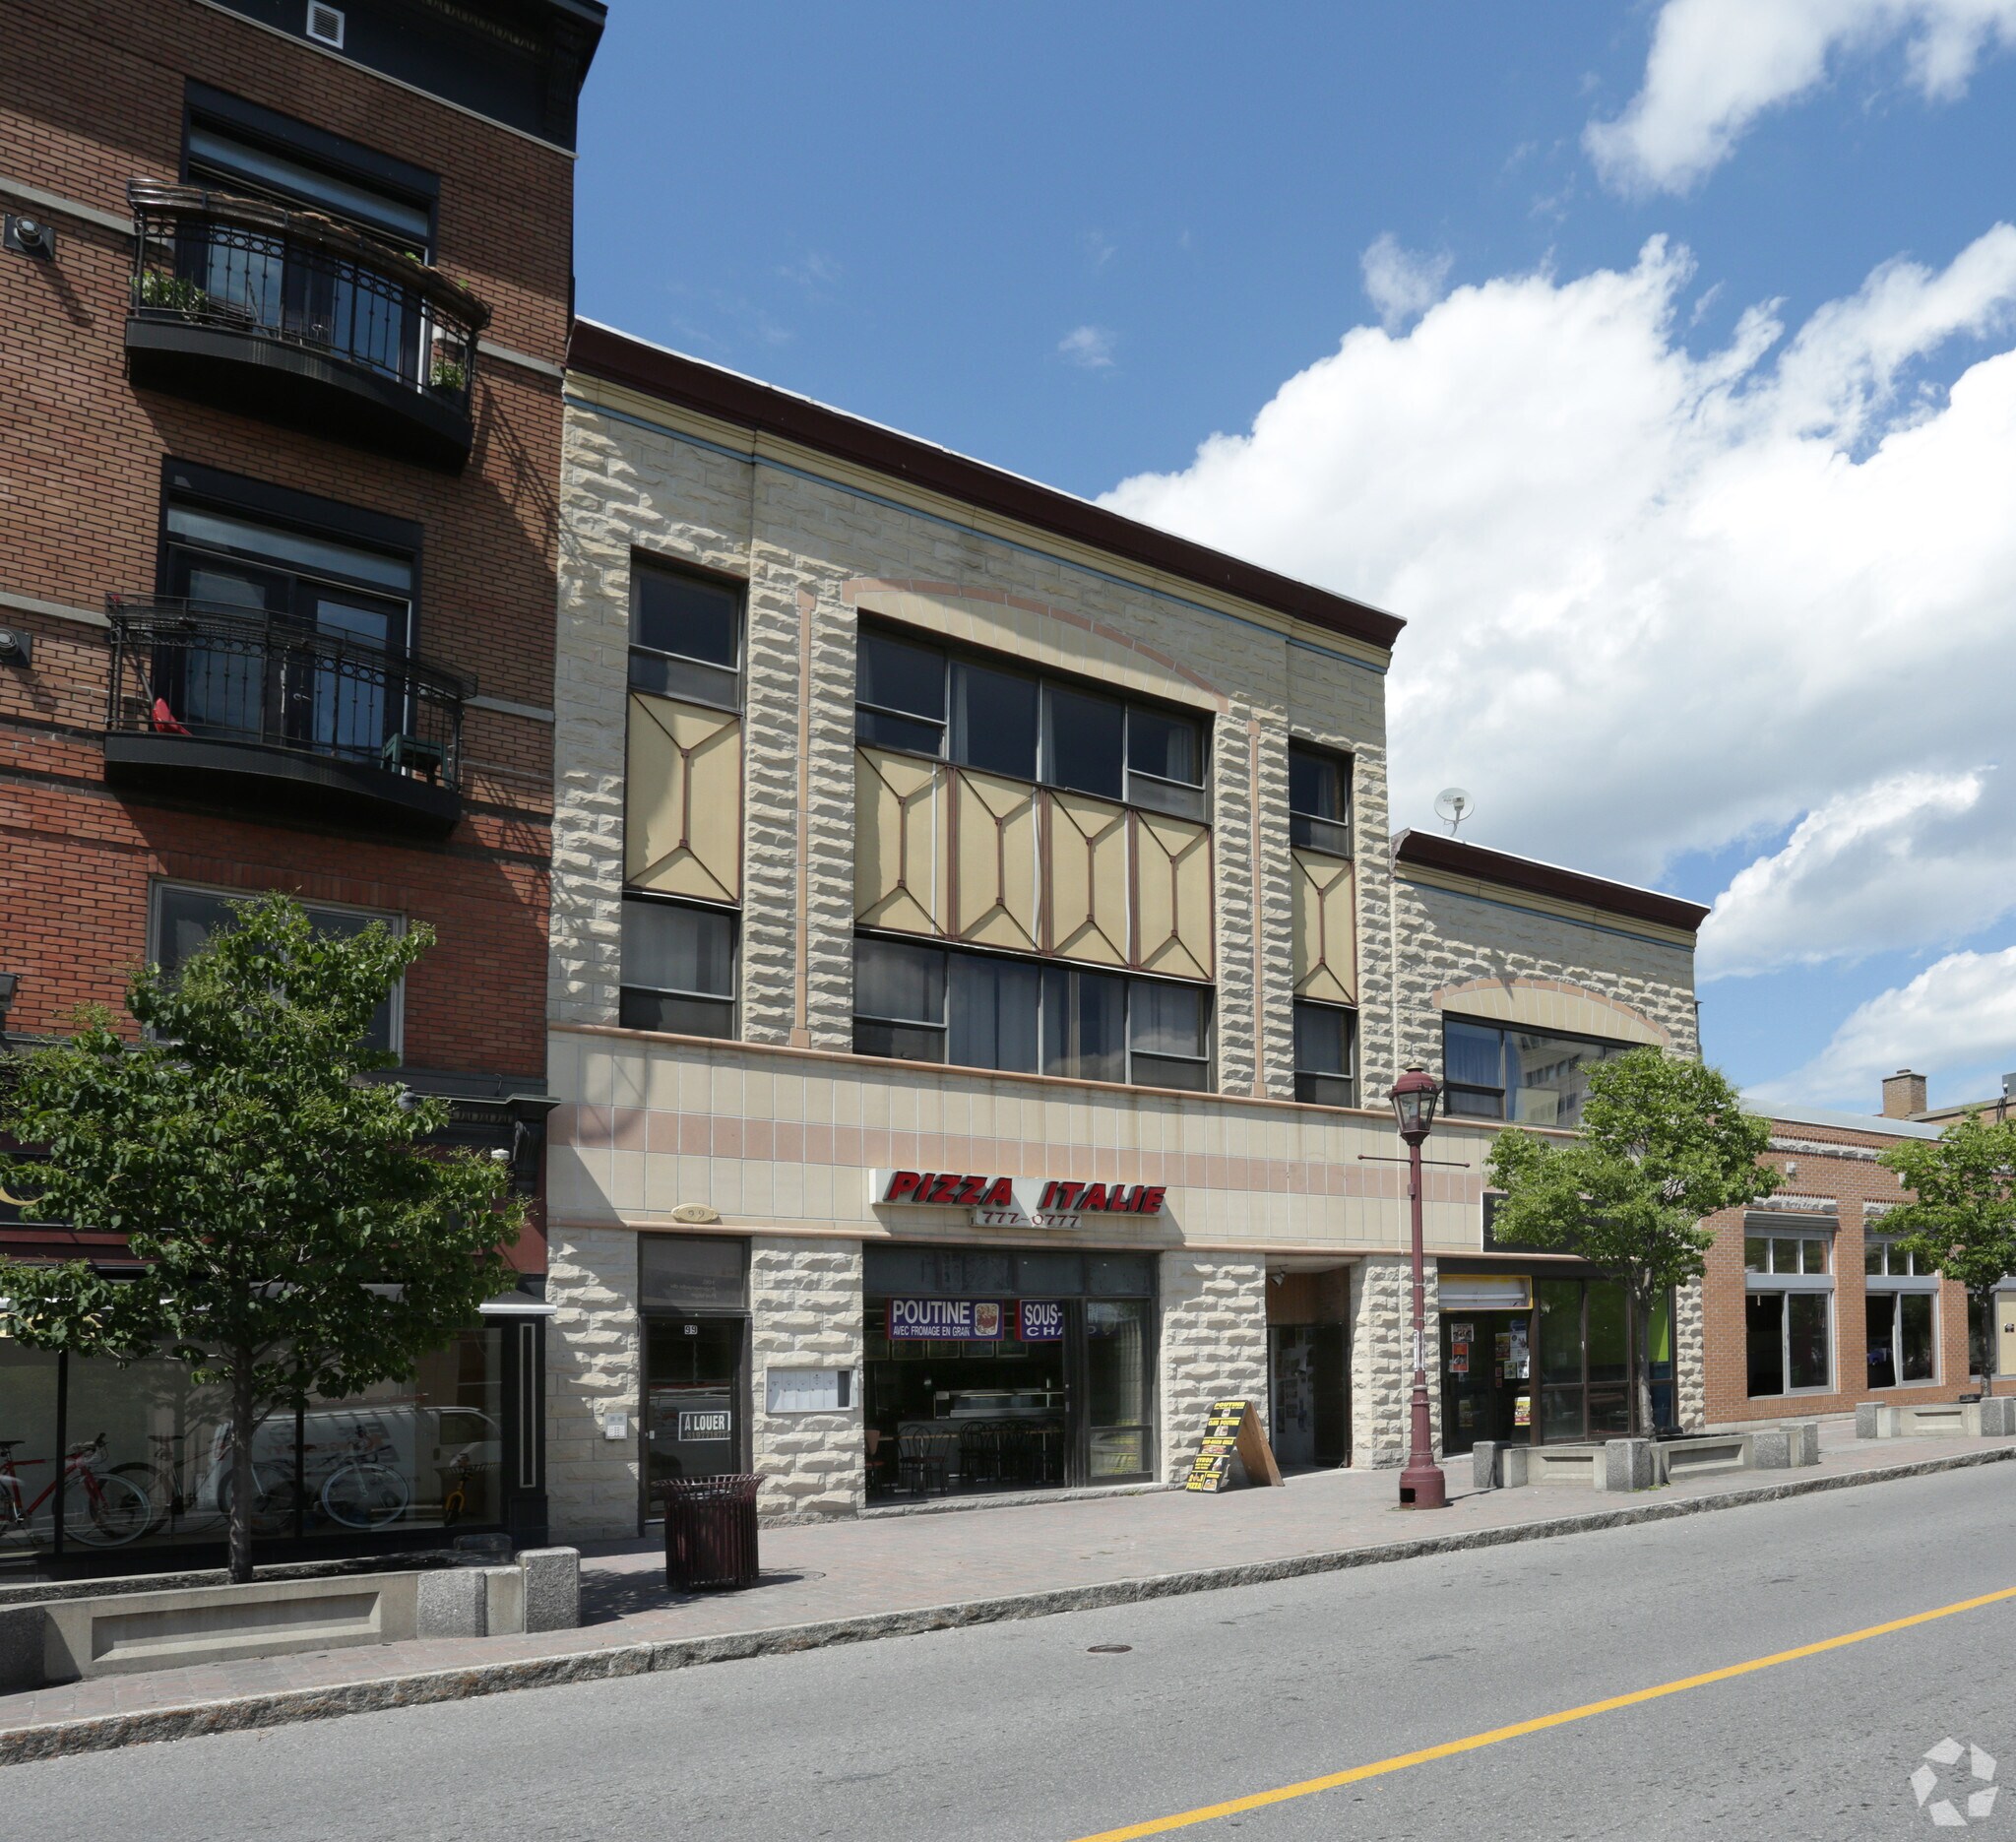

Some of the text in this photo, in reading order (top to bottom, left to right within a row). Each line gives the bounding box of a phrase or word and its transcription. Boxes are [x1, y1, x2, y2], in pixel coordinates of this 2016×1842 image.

[884, 1171, 1167, 1214] PIZZA ITALIE
[982, 1211, 1079, 1228] 777-0777
[893, 1300, 971, 1324] POUTINE
[685, 1325, 697, 1334] 99
[893, 1325, 971, 1337] AVEC FROMAGE EN GRAIN
[694, 1415, 724, 1430] LOUER
